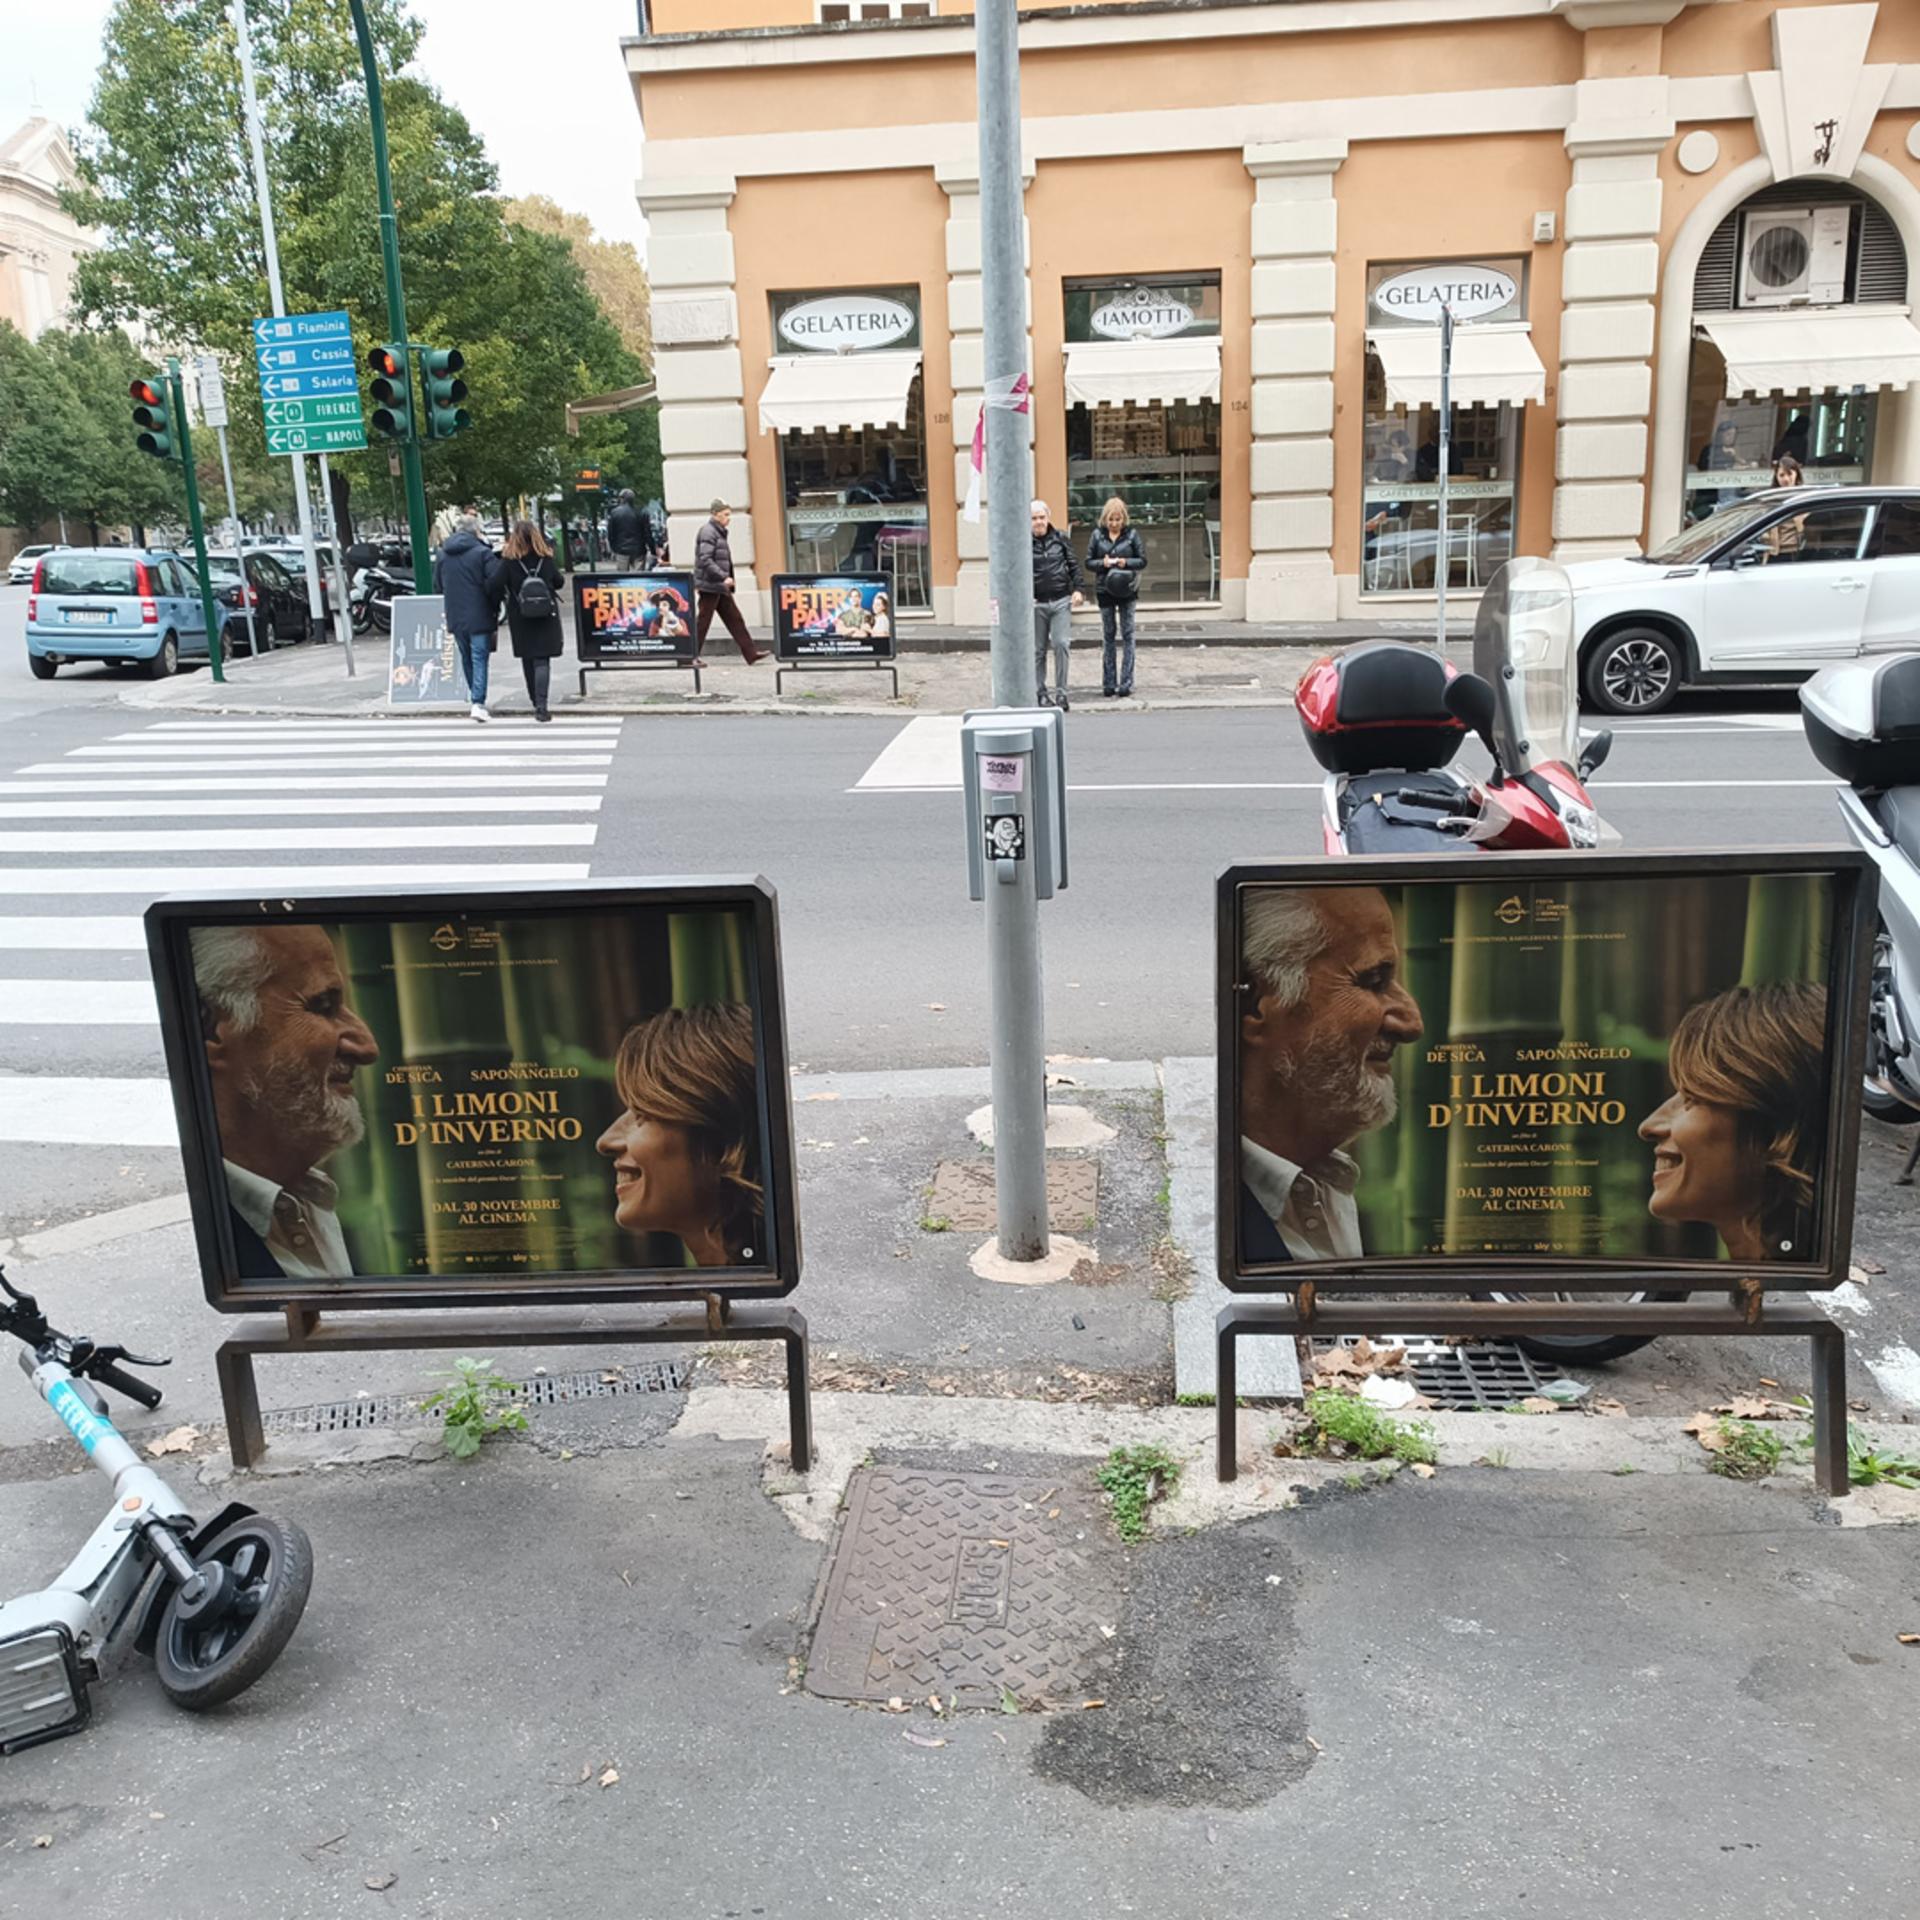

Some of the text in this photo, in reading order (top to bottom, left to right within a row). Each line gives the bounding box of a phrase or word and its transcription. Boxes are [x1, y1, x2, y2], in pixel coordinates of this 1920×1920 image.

[1386, 282, 1505, 304] GELATERIA
[790, 313, 902, 334] GELATERIA
[1103, 309, 1181, 326] IAMOTTI
[298, 320, 346, 335] Flaminia
[311, 348, 350, 361] Cassia
[311, 376, 353, 389] Salaria
[316, 402, 357, 416] FIRENZE
[326, 430, 363, 443] NAPOLI
[1813, 470, 1842, 481] TORTE
[795, 509, 849, 521] CIOCCOLATA
[582, 587, 648, 609] PETER
[781, 588, 848, 610] PETER
[594, 607, 644, 628] PAN
[1427, 1047, 1631, 1063] DE SICA SAPONANGELO
[386, 1066, 579, 1083] DE SICA SAPONANGELO
[1451, 1072, 1606, 1098] I LIMONI
[412, 1091, 560, 1117] I LIMONI
[1477, 1143, 1572, 1153] CATERINA CARONE
[446, 1158, 535, 1169] CATERINA CARONE
[1456, 1185, 1592, 1198] DAL 30 NOVEMBRE
[432, 1198, 560, 1213] DAL 30 NOVEMBRE
[1482, 1199, 1565, 1211] AL CINEMA
[459, 1212, 537, 1225] AL CINEMA
[1534, 1243, 1550, 1252] sky
